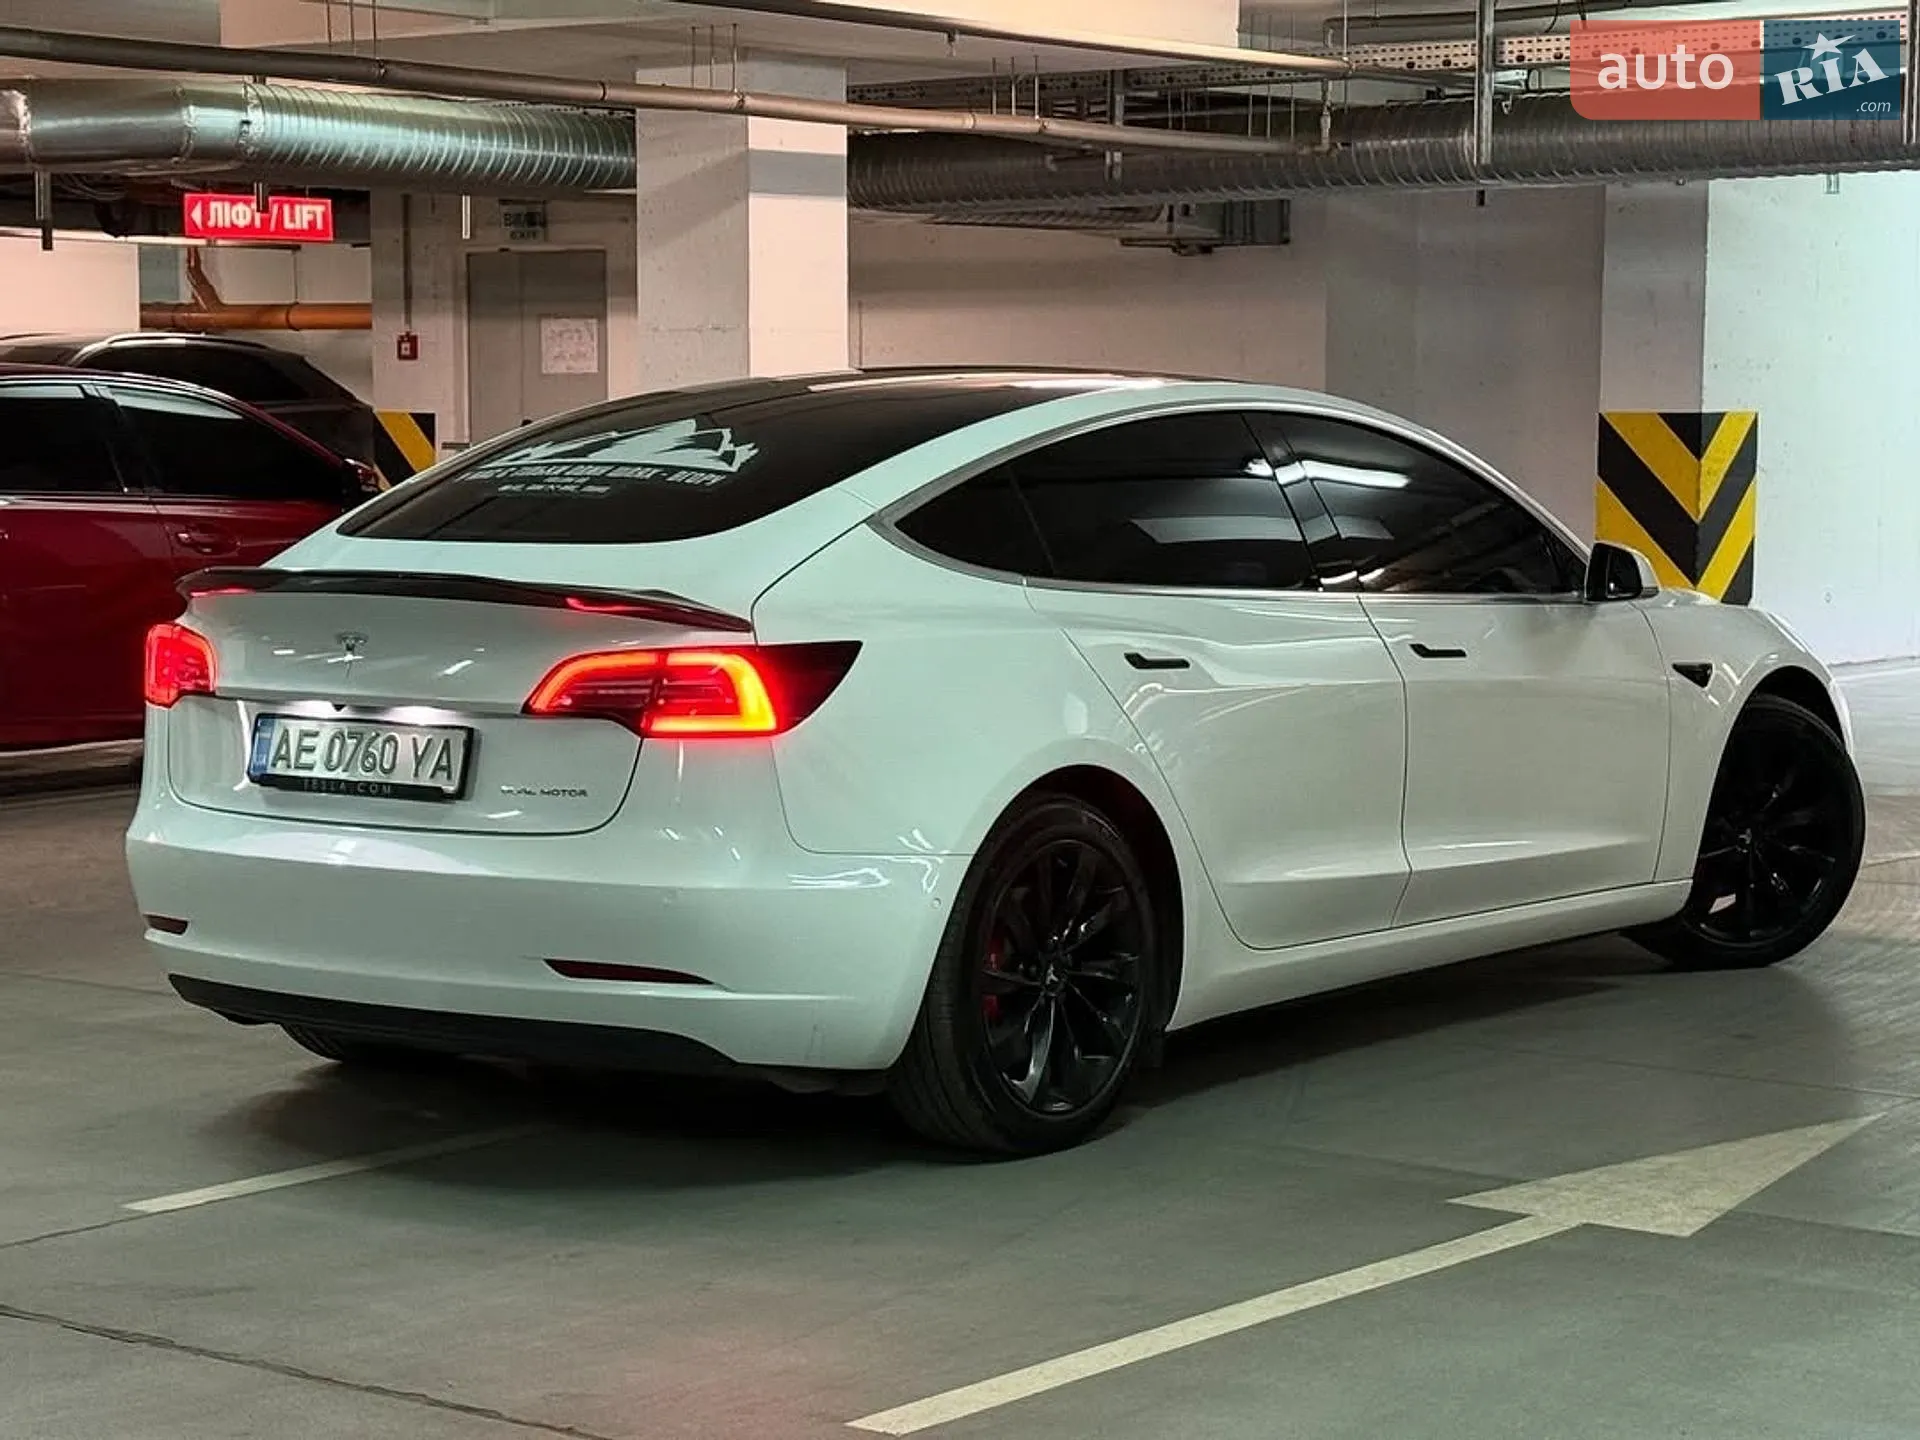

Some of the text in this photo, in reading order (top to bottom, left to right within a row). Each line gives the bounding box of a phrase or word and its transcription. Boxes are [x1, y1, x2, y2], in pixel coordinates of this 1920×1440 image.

[283, 204, 325, 230] LIFT
[271, 728, 452, 780] AE 0760 YA
[540, 788, 588, 798] MOTOR
